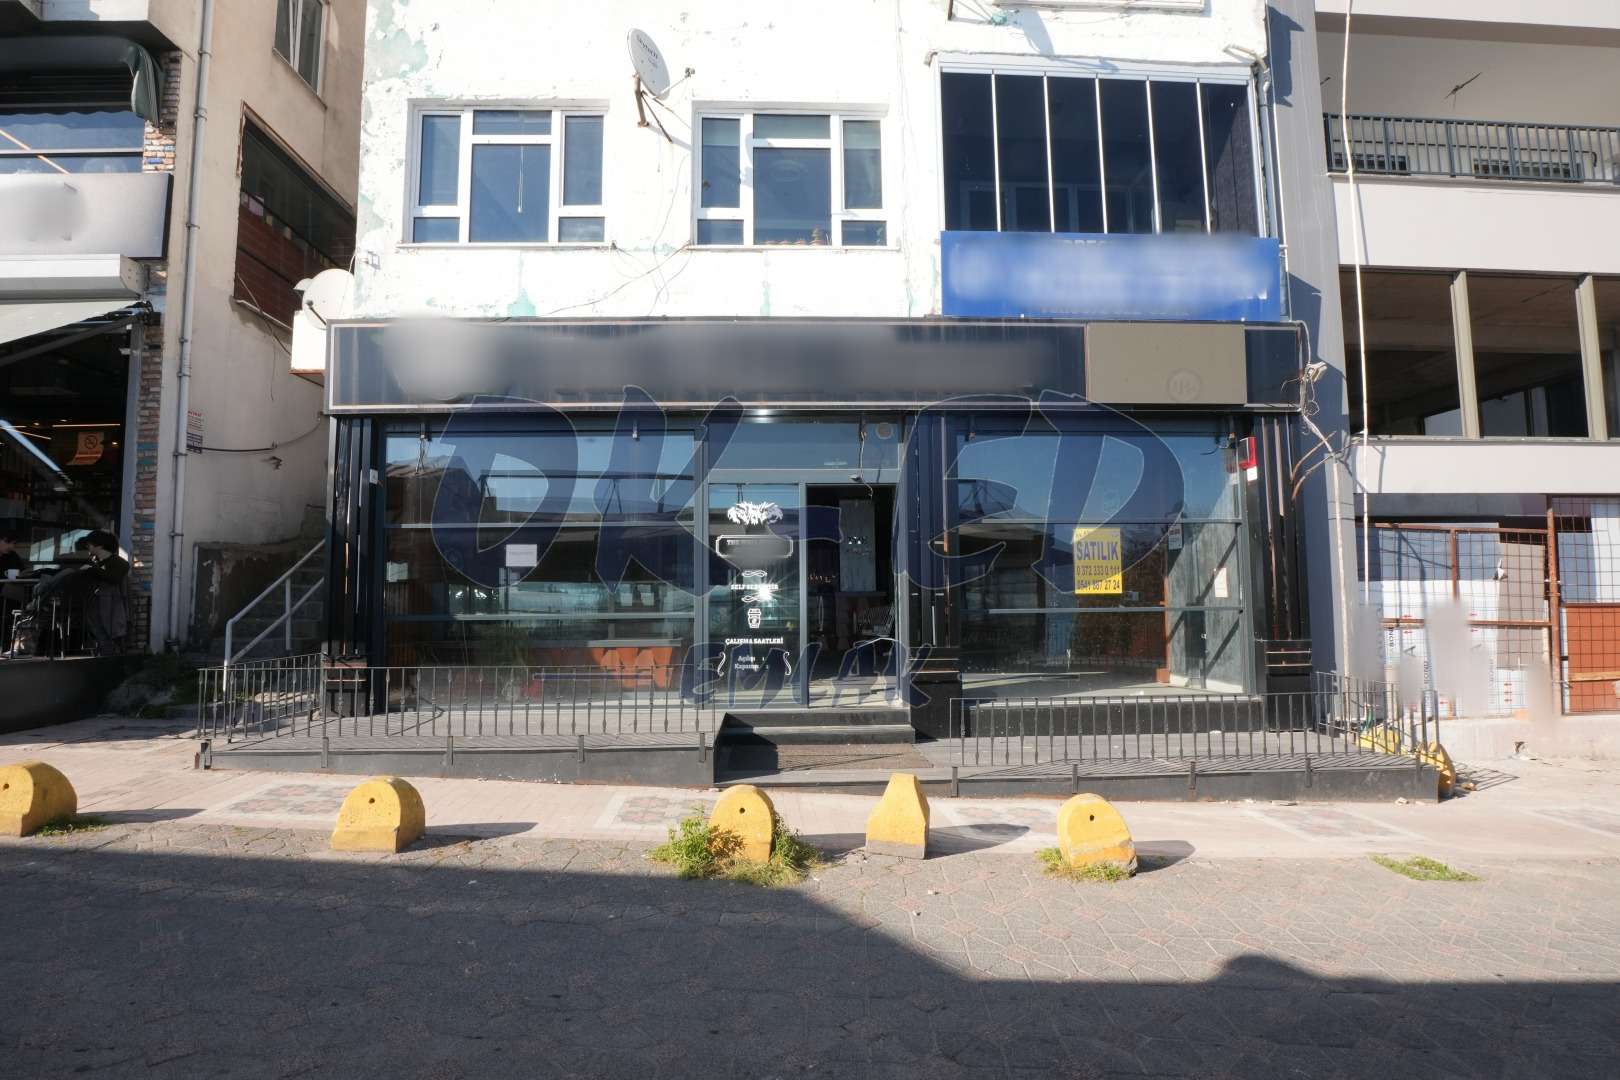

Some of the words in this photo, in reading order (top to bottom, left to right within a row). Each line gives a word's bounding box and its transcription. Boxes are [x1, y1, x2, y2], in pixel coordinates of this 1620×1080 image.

[1076, 541, 1119, 560] SATILIK
[725, 637, 753, 646] ÇALIŞMA
[753, 636, 784, 645] SAATLERİ
